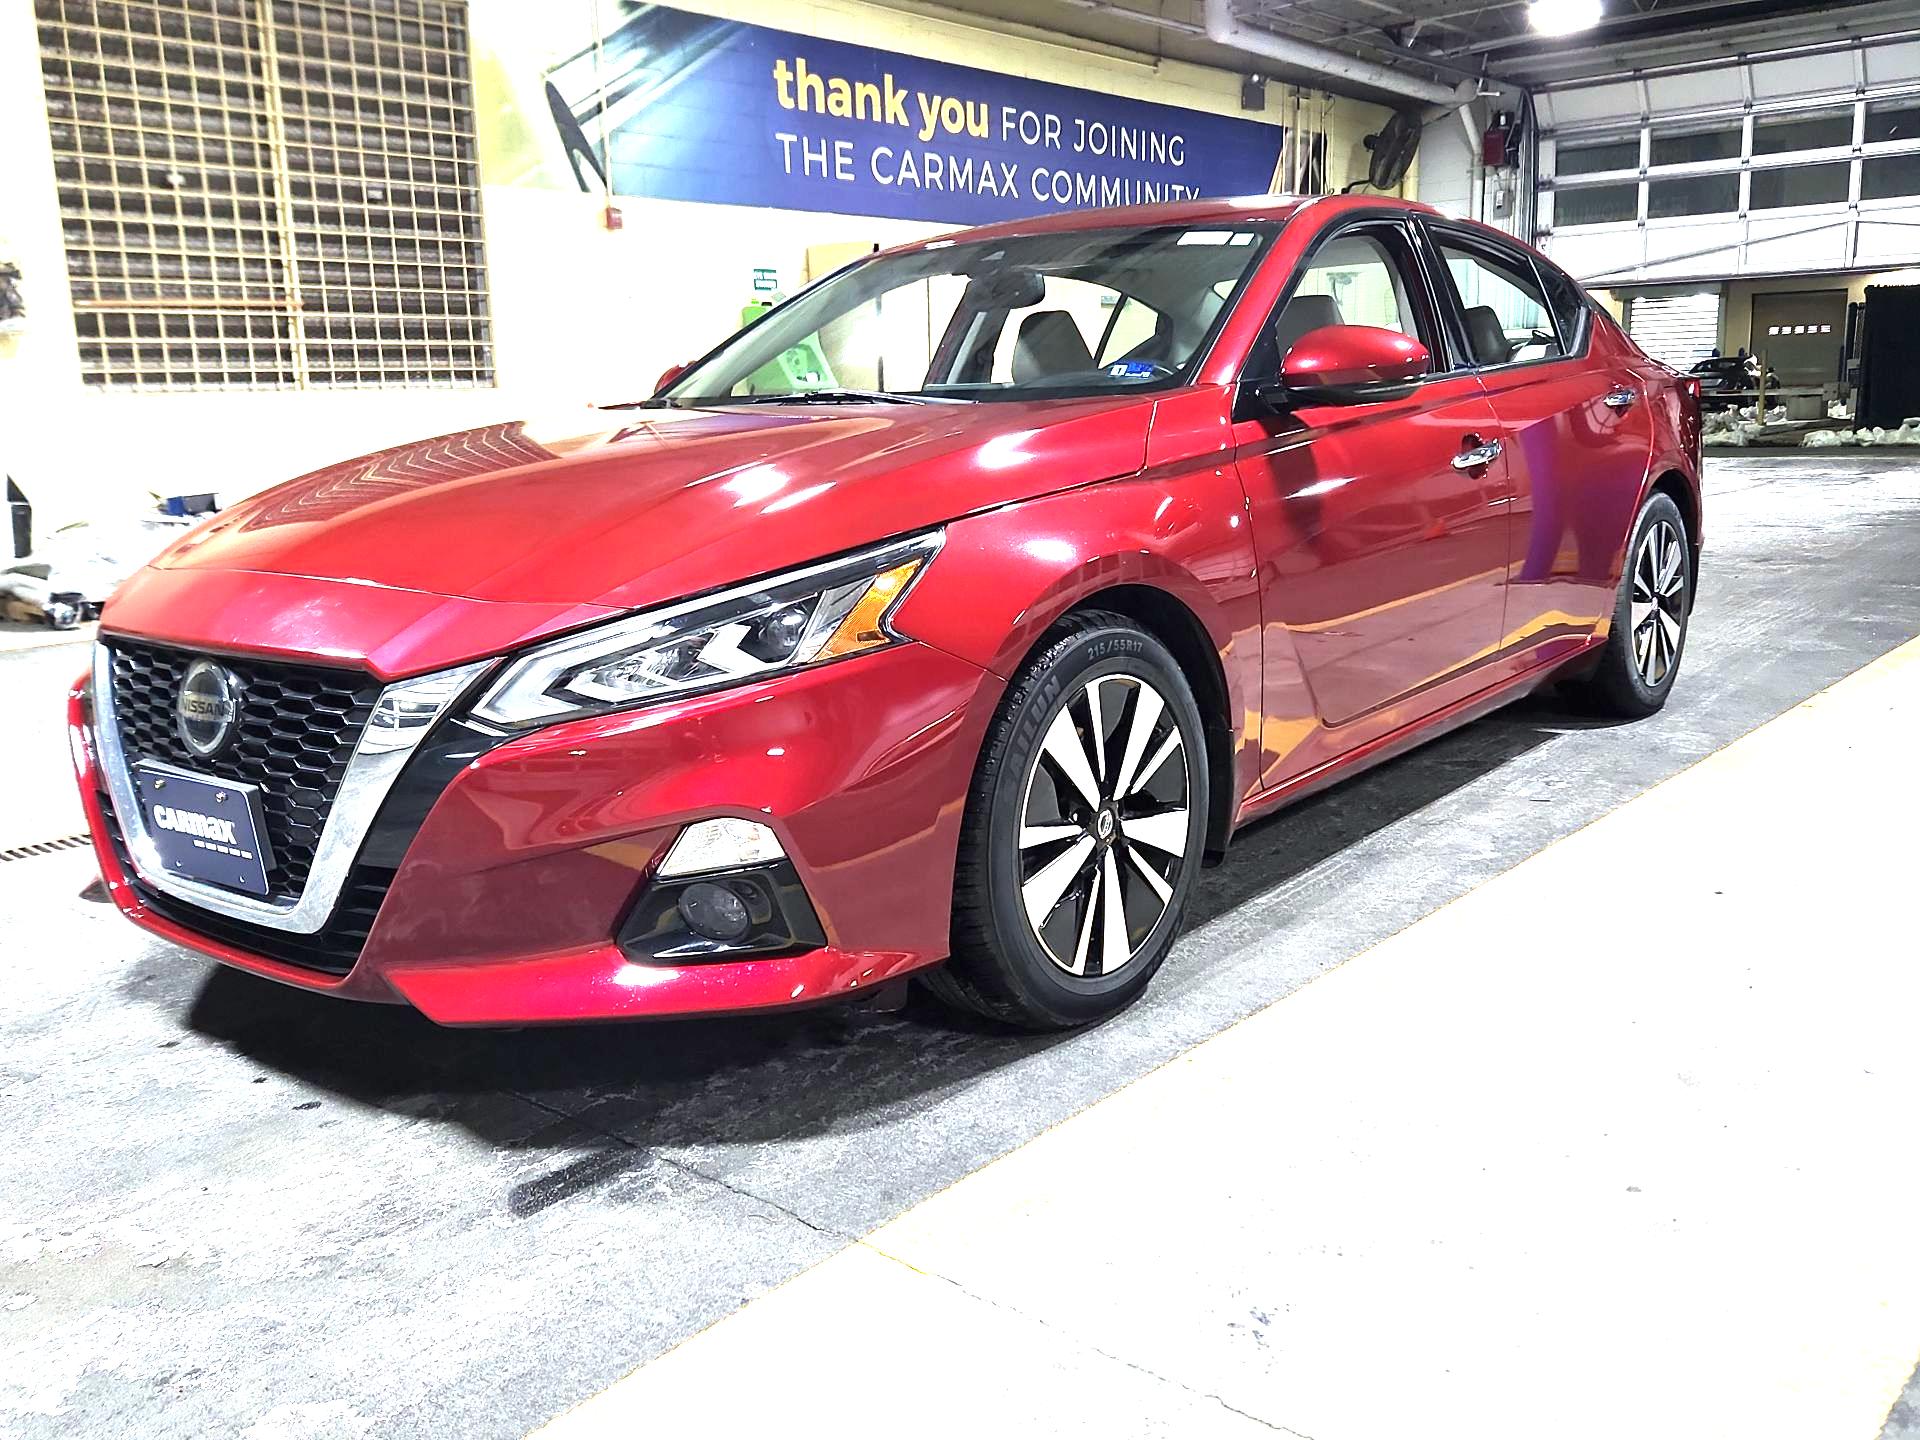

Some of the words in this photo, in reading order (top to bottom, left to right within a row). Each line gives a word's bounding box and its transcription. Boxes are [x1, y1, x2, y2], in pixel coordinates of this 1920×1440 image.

[773, 57, 909, 127] thank
[917, 92, 989, 141] you
[1002, 106, 1062, 150] FOR
[1073, 118, 1184, 166] JOINING
[775, 132, 855, 181] THE
[870, 146, 1019, 199] CARMAX
[1087, 639, 1143, 661] 215/55R17
[184, 698, 225, 717] NISSAN
[1002, 674, 1061, 800] AILUN
